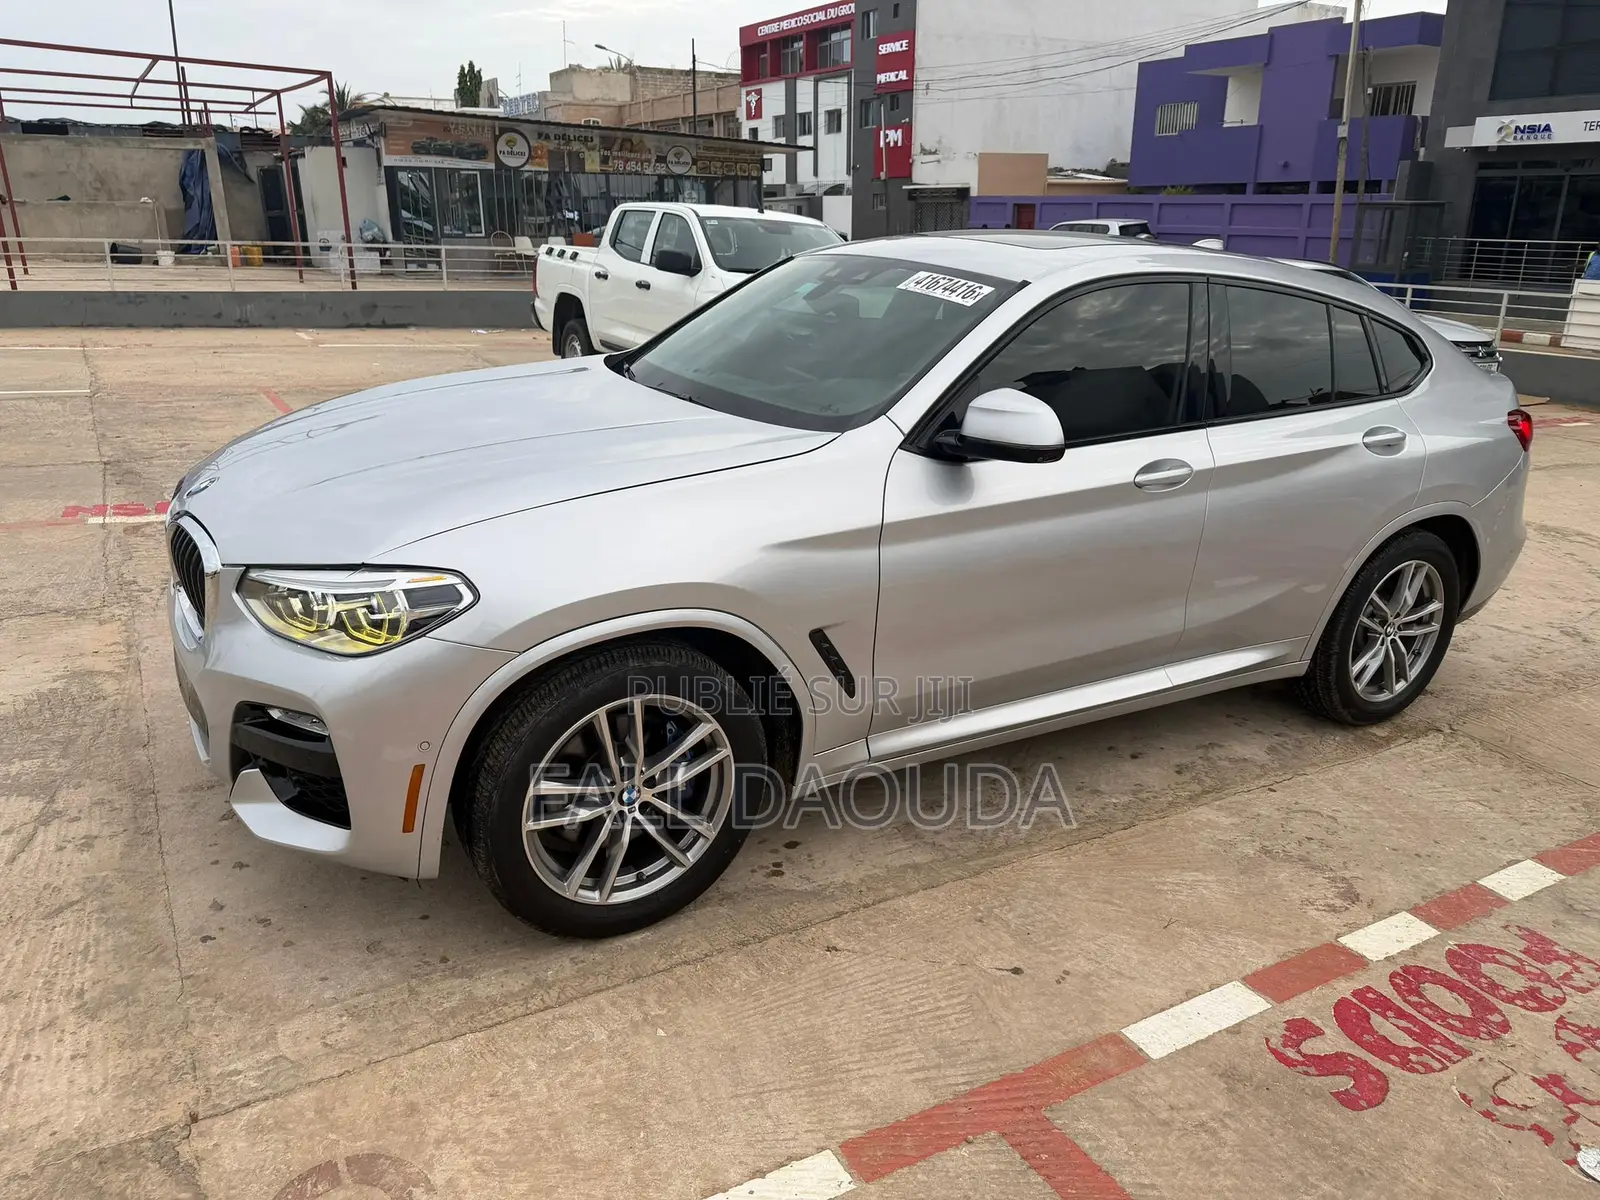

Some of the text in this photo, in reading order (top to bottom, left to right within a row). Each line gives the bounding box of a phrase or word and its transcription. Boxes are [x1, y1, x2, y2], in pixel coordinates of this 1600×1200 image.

[757, 23, 780, 37] CENTRE
[780, 16, 803, 31] MEDICO
[803, 10, 827, 26] SOCIAL
[827, 7, 838, 19] DU
[878, 40, 909, 55] SERVICE
[876, 70, 909, 84] MEDICAL
[1514, 123, 1553, 135] NSIA
[1513, 133, 1552, 141] BANQUE
